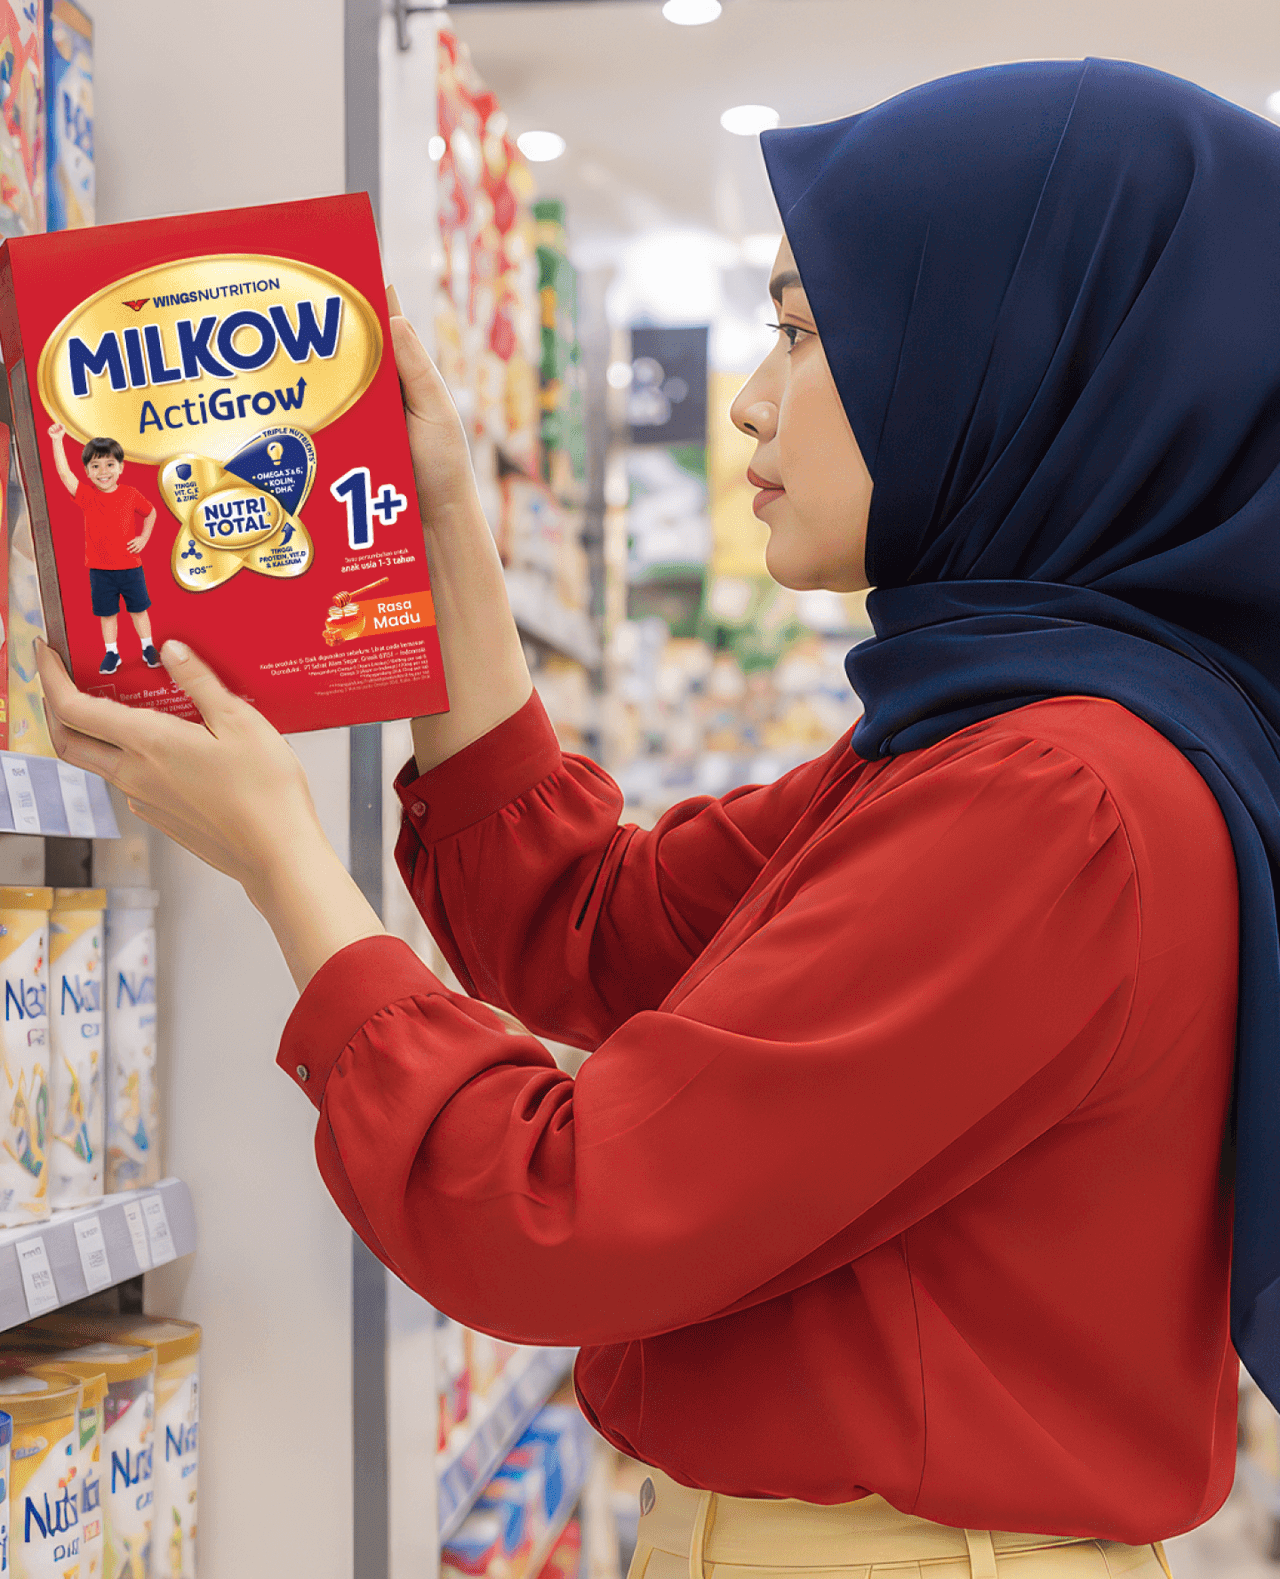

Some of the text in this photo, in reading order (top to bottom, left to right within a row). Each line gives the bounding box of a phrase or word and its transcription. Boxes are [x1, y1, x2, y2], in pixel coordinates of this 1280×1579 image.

[67, 295, 343, 398] MILKOW
[139, 377, 308, 433] ActiGrow
[262, 427, 288, 438] TRIPLE
[257, 471, 284, 480] OMEGA
[204, 497, 267, 521] NUTRI
[332, 468, 405, 548] 1+
[204, 514, 271, 537] TOTAL
[341, 563, 360, 573] anak
[361, 561, 377, 570] usia
[378, 557, 391, 567] 1-3
[377, 600, 412, 614] Rasa
[373, 612, 421, 629] Madu
